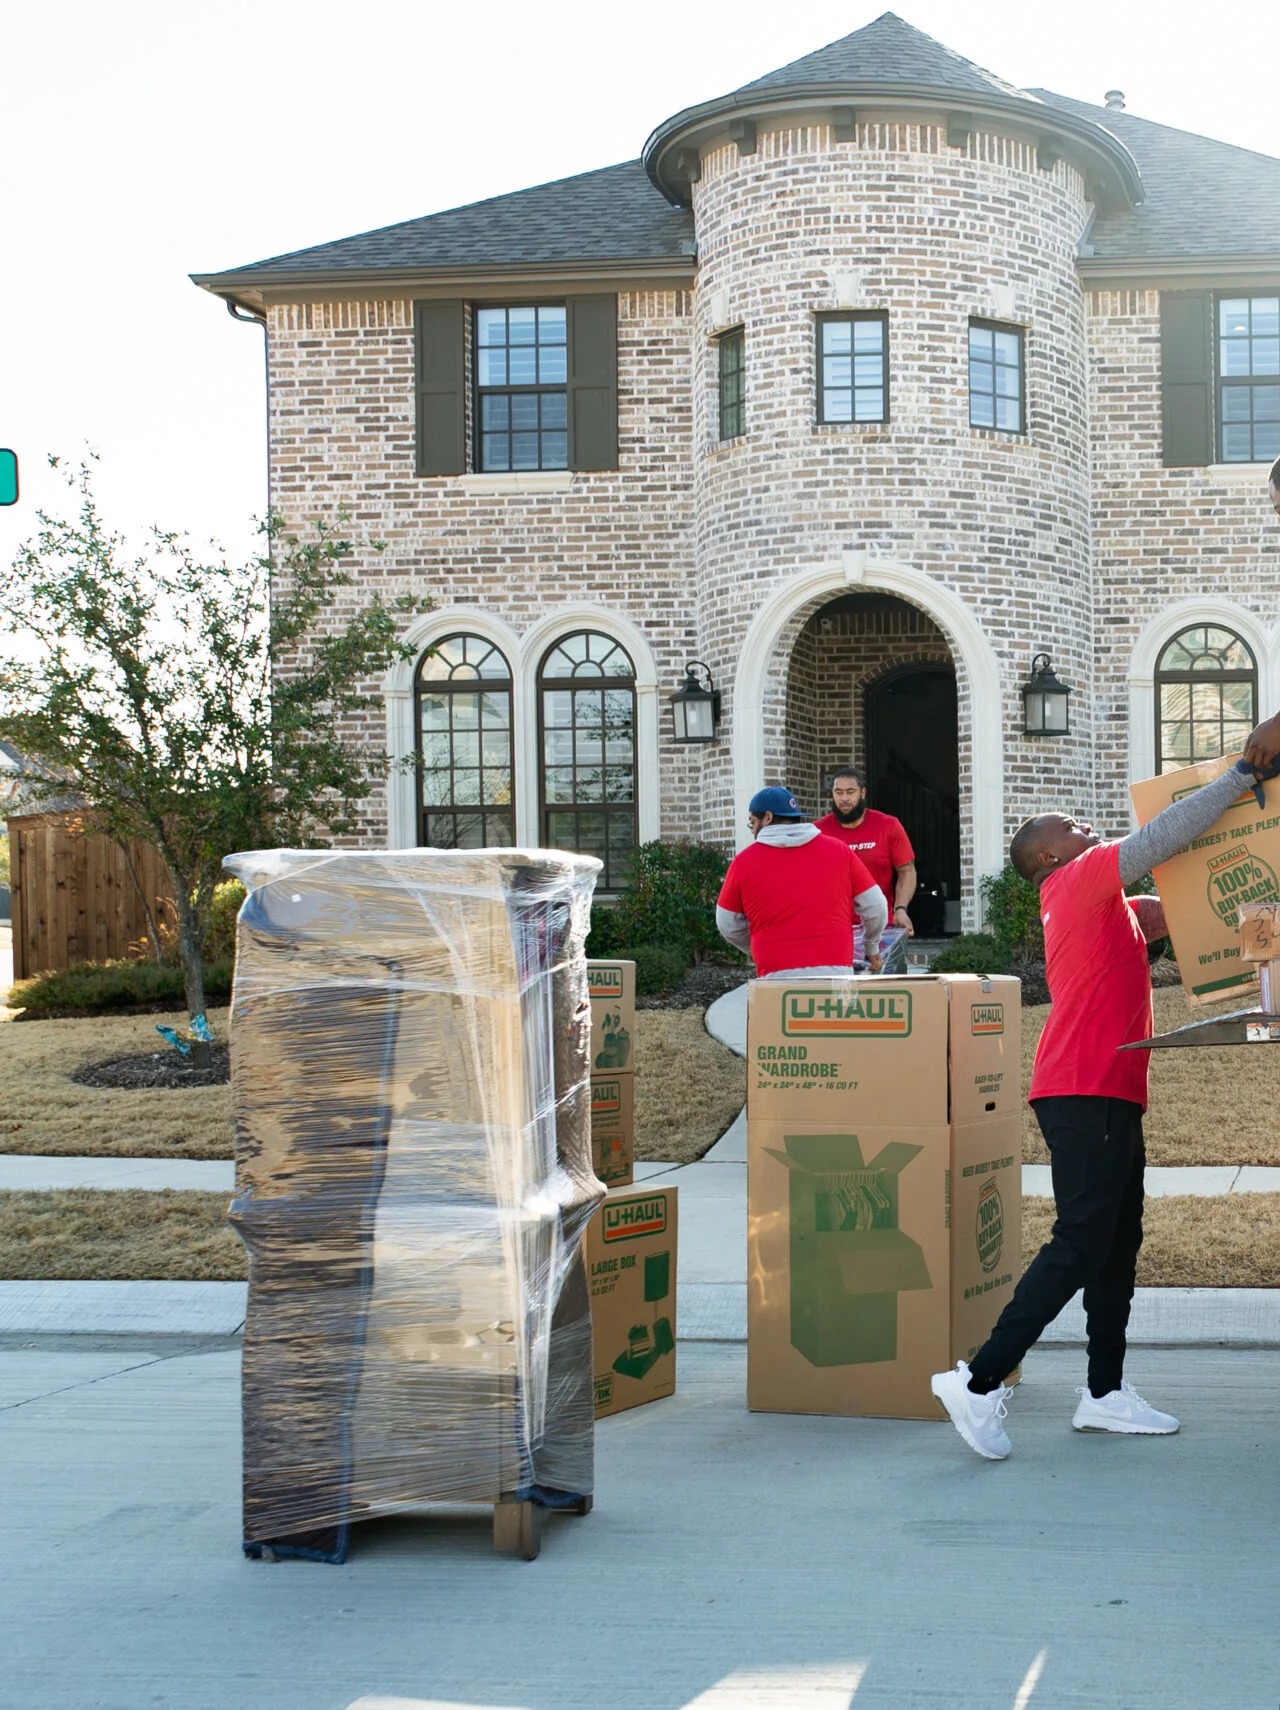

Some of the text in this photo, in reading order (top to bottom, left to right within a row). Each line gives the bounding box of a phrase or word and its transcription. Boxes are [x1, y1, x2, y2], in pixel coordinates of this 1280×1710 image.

[1192, 832, 1227, 850] BOXES?
[1229, 824, 1253, 839] TAKE
[1210, 847, 1246, 868] U-HAUL
[1213, 860, 1262, 897] 100%
[1216, 878, 1275, 915] BUY-BACK
[1198, 947, 1241, 965] We'll Buy
[588, 972, 620, 986] HAUL
[791, 998, 904, 1019] U-HAUL
[973, 1009, 1002, 1024] U-HAUL
[757, 1045, 808, 1061] GRAND
[757, 1062, 839, 1078] WARDROBE
[593, 1085, 618, 1101] AUL
[836, 1081, 847, 1090] CU
[848, 1081, 859, 1090] FT
[607, 1202, 663, 1228] U-HAUL
[591, 1254, 637, 1277] LARGE BOX
